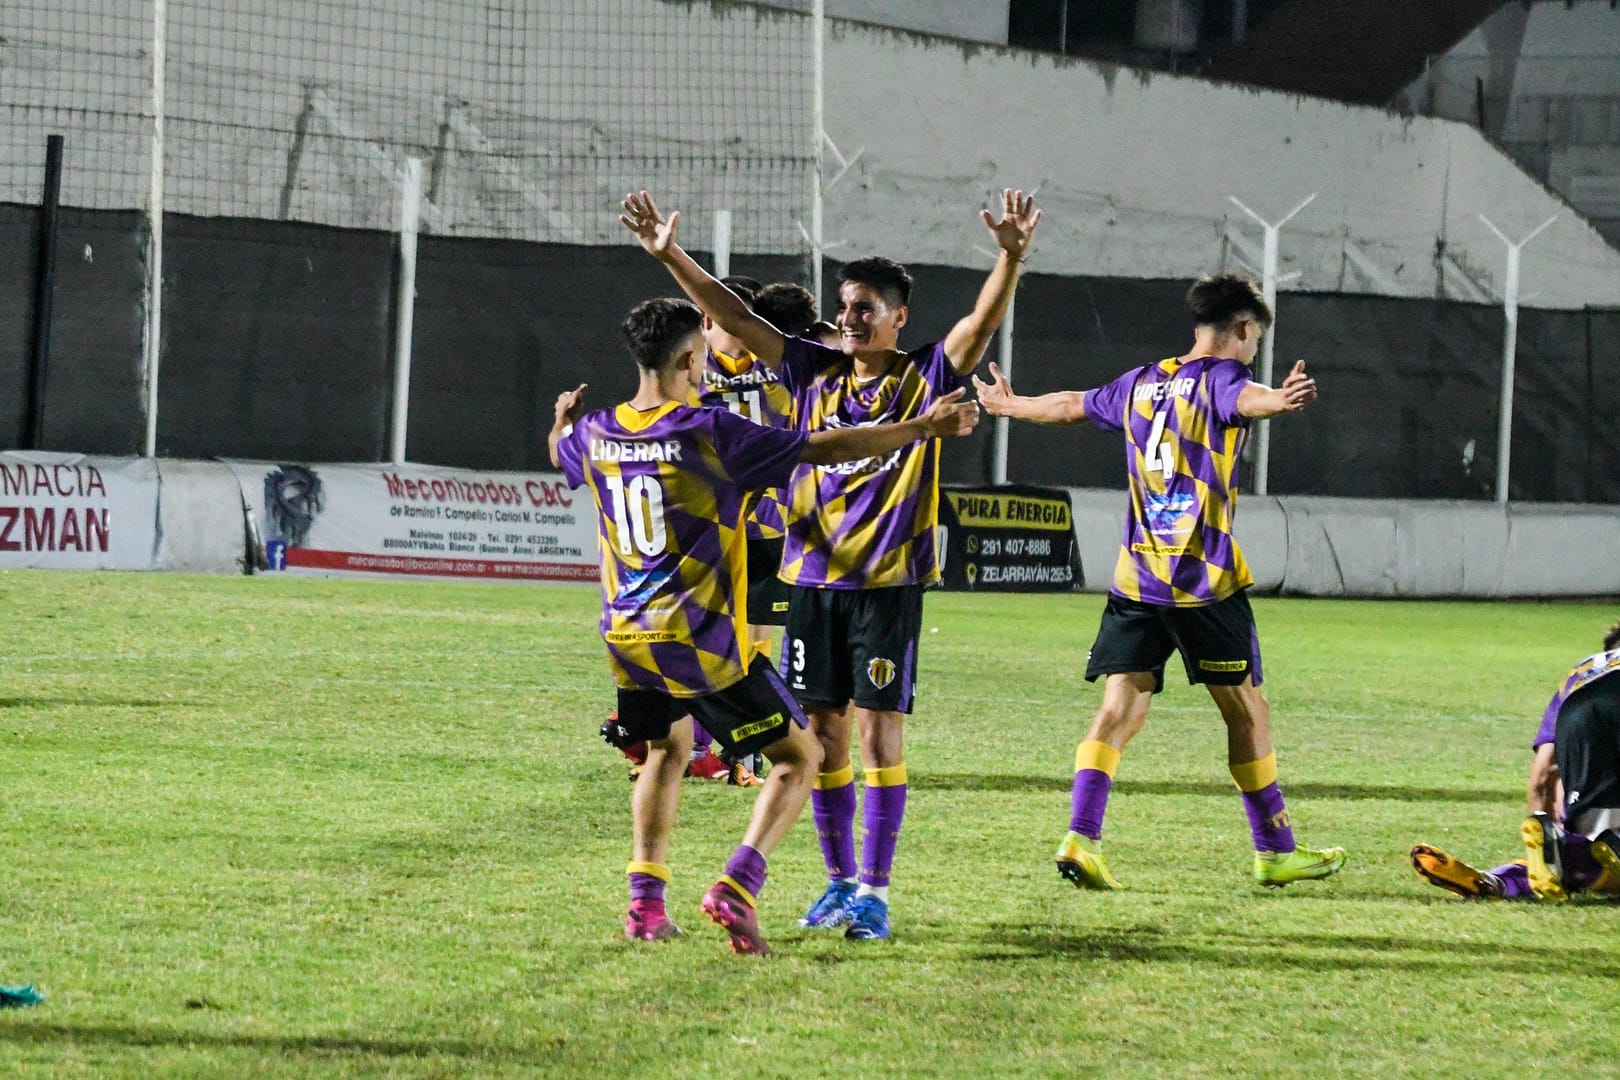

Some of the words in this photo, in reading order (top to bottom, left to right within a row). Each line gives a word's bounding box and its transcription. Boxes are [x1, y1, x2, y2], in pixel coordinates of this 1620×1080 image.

[591, 440, 683, 462] LIDERAR
[1145, 411, 1174, 480] 4
[526, 481, 573, 509] C&C
[390, 505, 402, 517] de
[606, 474, 667, 557] 10
[958, 497, 1001, 519] PURA
[539, 546, 582, 557] ARGENTINA
[982, 538, 1001, 555] 291
[982, 562, 1049, 583] ZELARRAYÁN
[793, 638, 805, 672] 3
